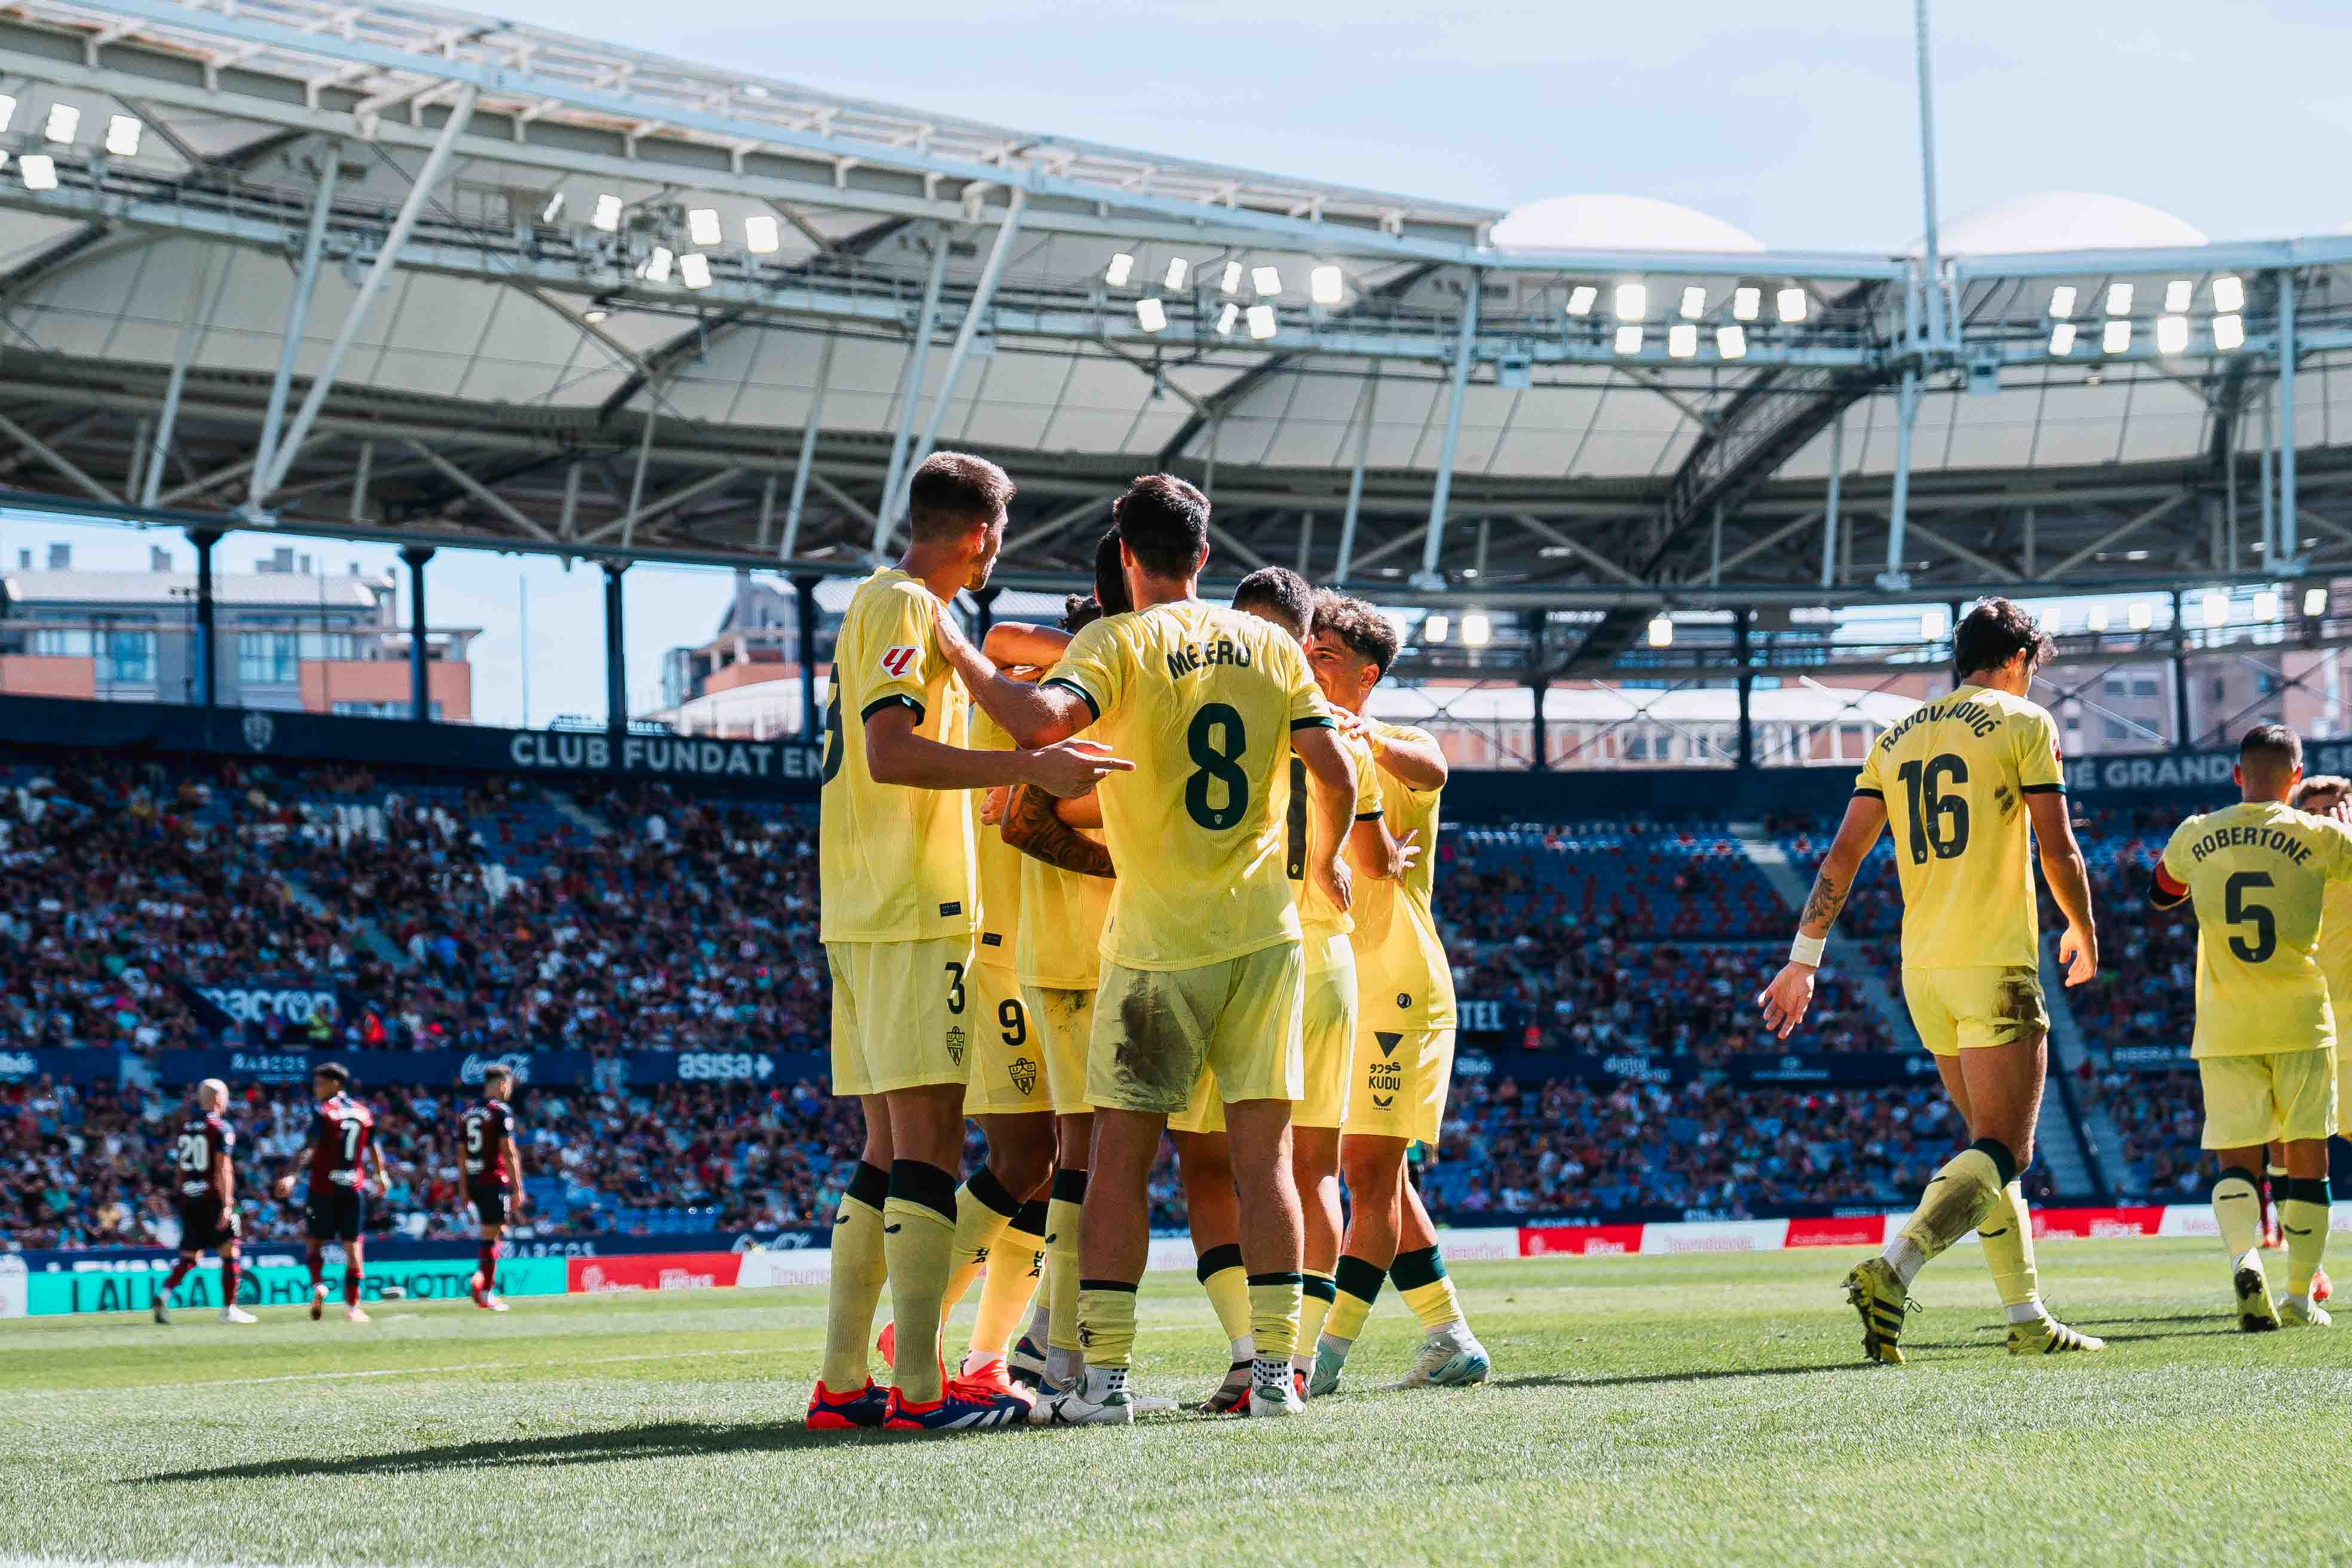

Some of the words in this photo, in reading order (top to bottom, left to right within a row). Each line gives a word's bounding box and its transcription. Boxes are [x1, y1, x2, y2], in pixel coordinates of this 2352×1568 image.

[1881, 702, 2001, 753] RADOVNOVIĆ
[510, 734, 610, 769] CLUB
[623, 739, 773, 775] FUNDAT
[1185, 702, 1249, 831] 8
[2103, 754, 2236, 786] GRAND
[1897, 753, 1970, 865] 16
[2191, 826, 2313, 866] ROBERTONE
[2225, 871, 2277, 964] 5
[944, 961, 966, 1015] 3
[998, 999, 1027, 1046] 9
[678, 1052, 752, 1080] asisa
[1368, 1076, 1401, 1091] KUDU
[177, 1134, 209, 1172] 20
[339, 1119, 360, 1161] 7
[466, 1117, 483, 1154] 5
